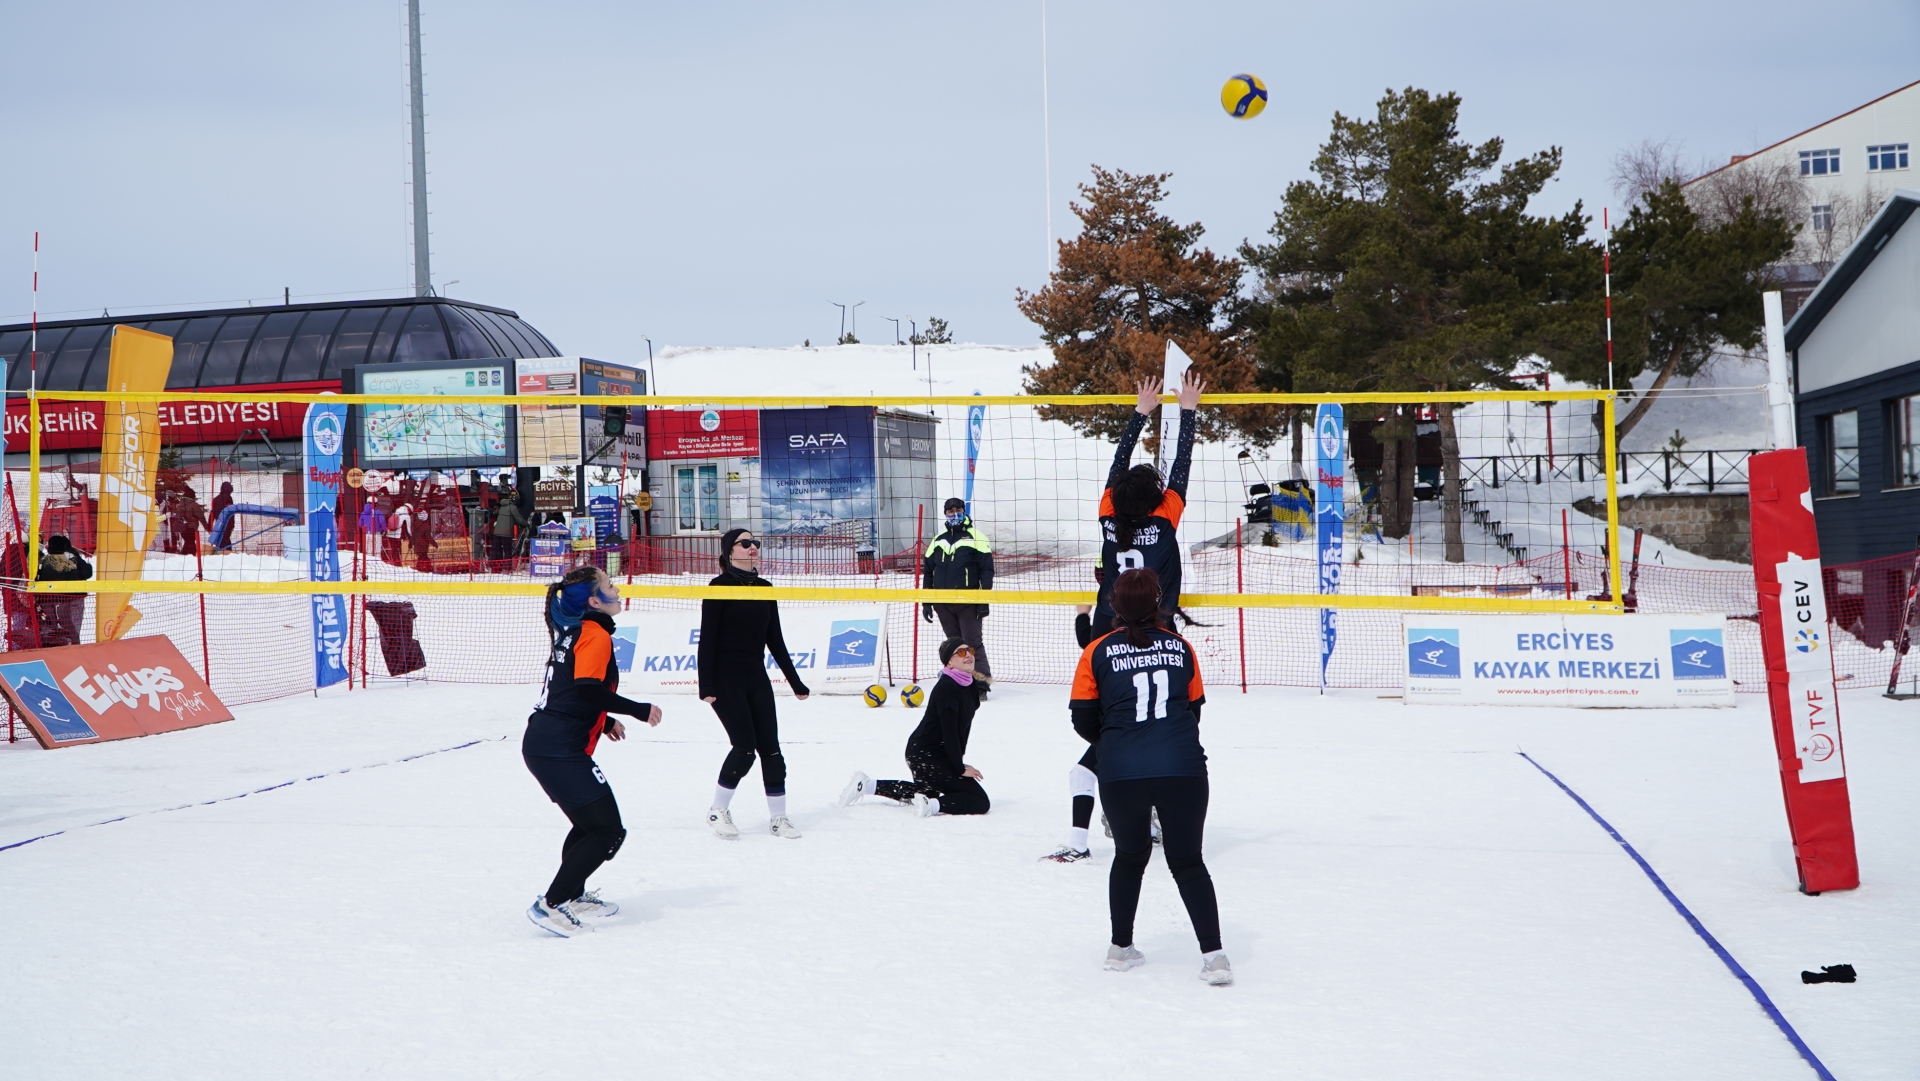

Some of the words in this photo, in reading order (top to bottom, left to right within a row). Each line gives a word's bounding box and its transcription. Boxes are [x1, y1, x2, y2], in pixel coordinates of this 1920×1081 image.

[369, 378, 420, 392] erciyes
[123, 415, 141, 484] SPOR
[789, 433, 846, 448] SAFA
[535, 482, 572, 492] ERCİYES
[1794, 580, 1812, 623] CEV
[1165, 639, 1186, 654] GÜL
[1517, 628, 1614, 651] ERCİYES
[643, 656, 698, 672] KAYA
[1111, 651, 1184, 672] ÜNİVERSİTESİ
[1473, 661, 1551, 679] KAYAK
[1558, 657, 1661, 679] MERKEZİ
[62, 663, 184, 716] Erciyes
[1132, 669, 1169, 722] 11
[1807, 689, 1825, 730] TVF
[592, 766, 606, 784] 6
